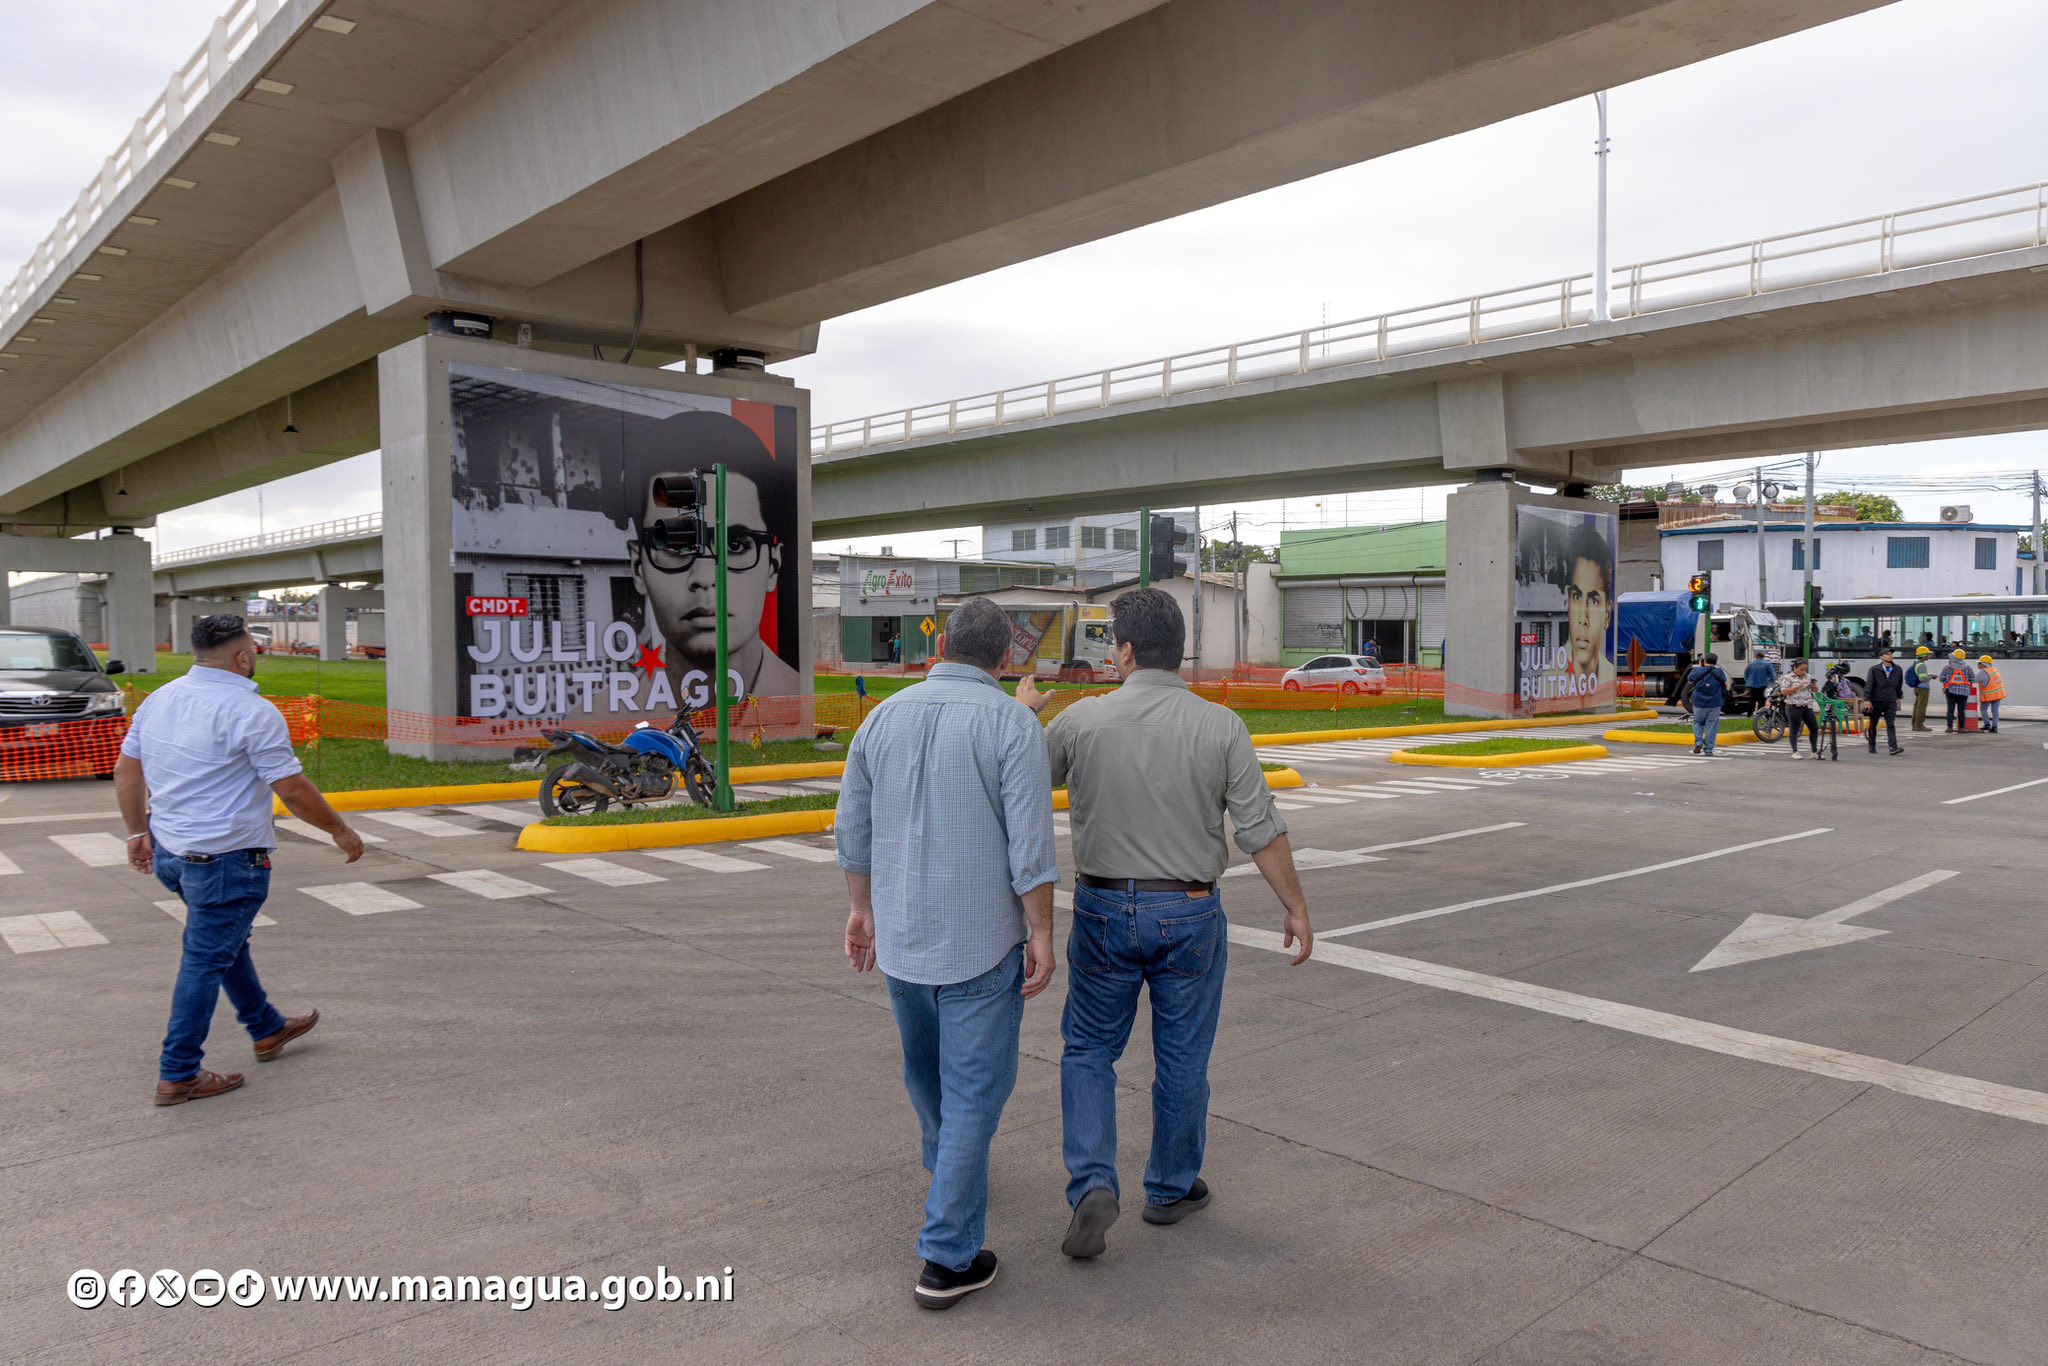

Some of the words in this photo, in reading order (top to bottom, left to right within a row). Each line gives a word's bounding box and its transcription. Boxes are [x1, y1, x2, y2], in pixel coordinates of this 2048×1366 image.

[469, 598, 524, 614] CMDT.
[466, 620, 637, 664] JULIO
[1520, 645, 1567, 672] JULIO
[1520, 672, 1598, 701] BUITRAGO
